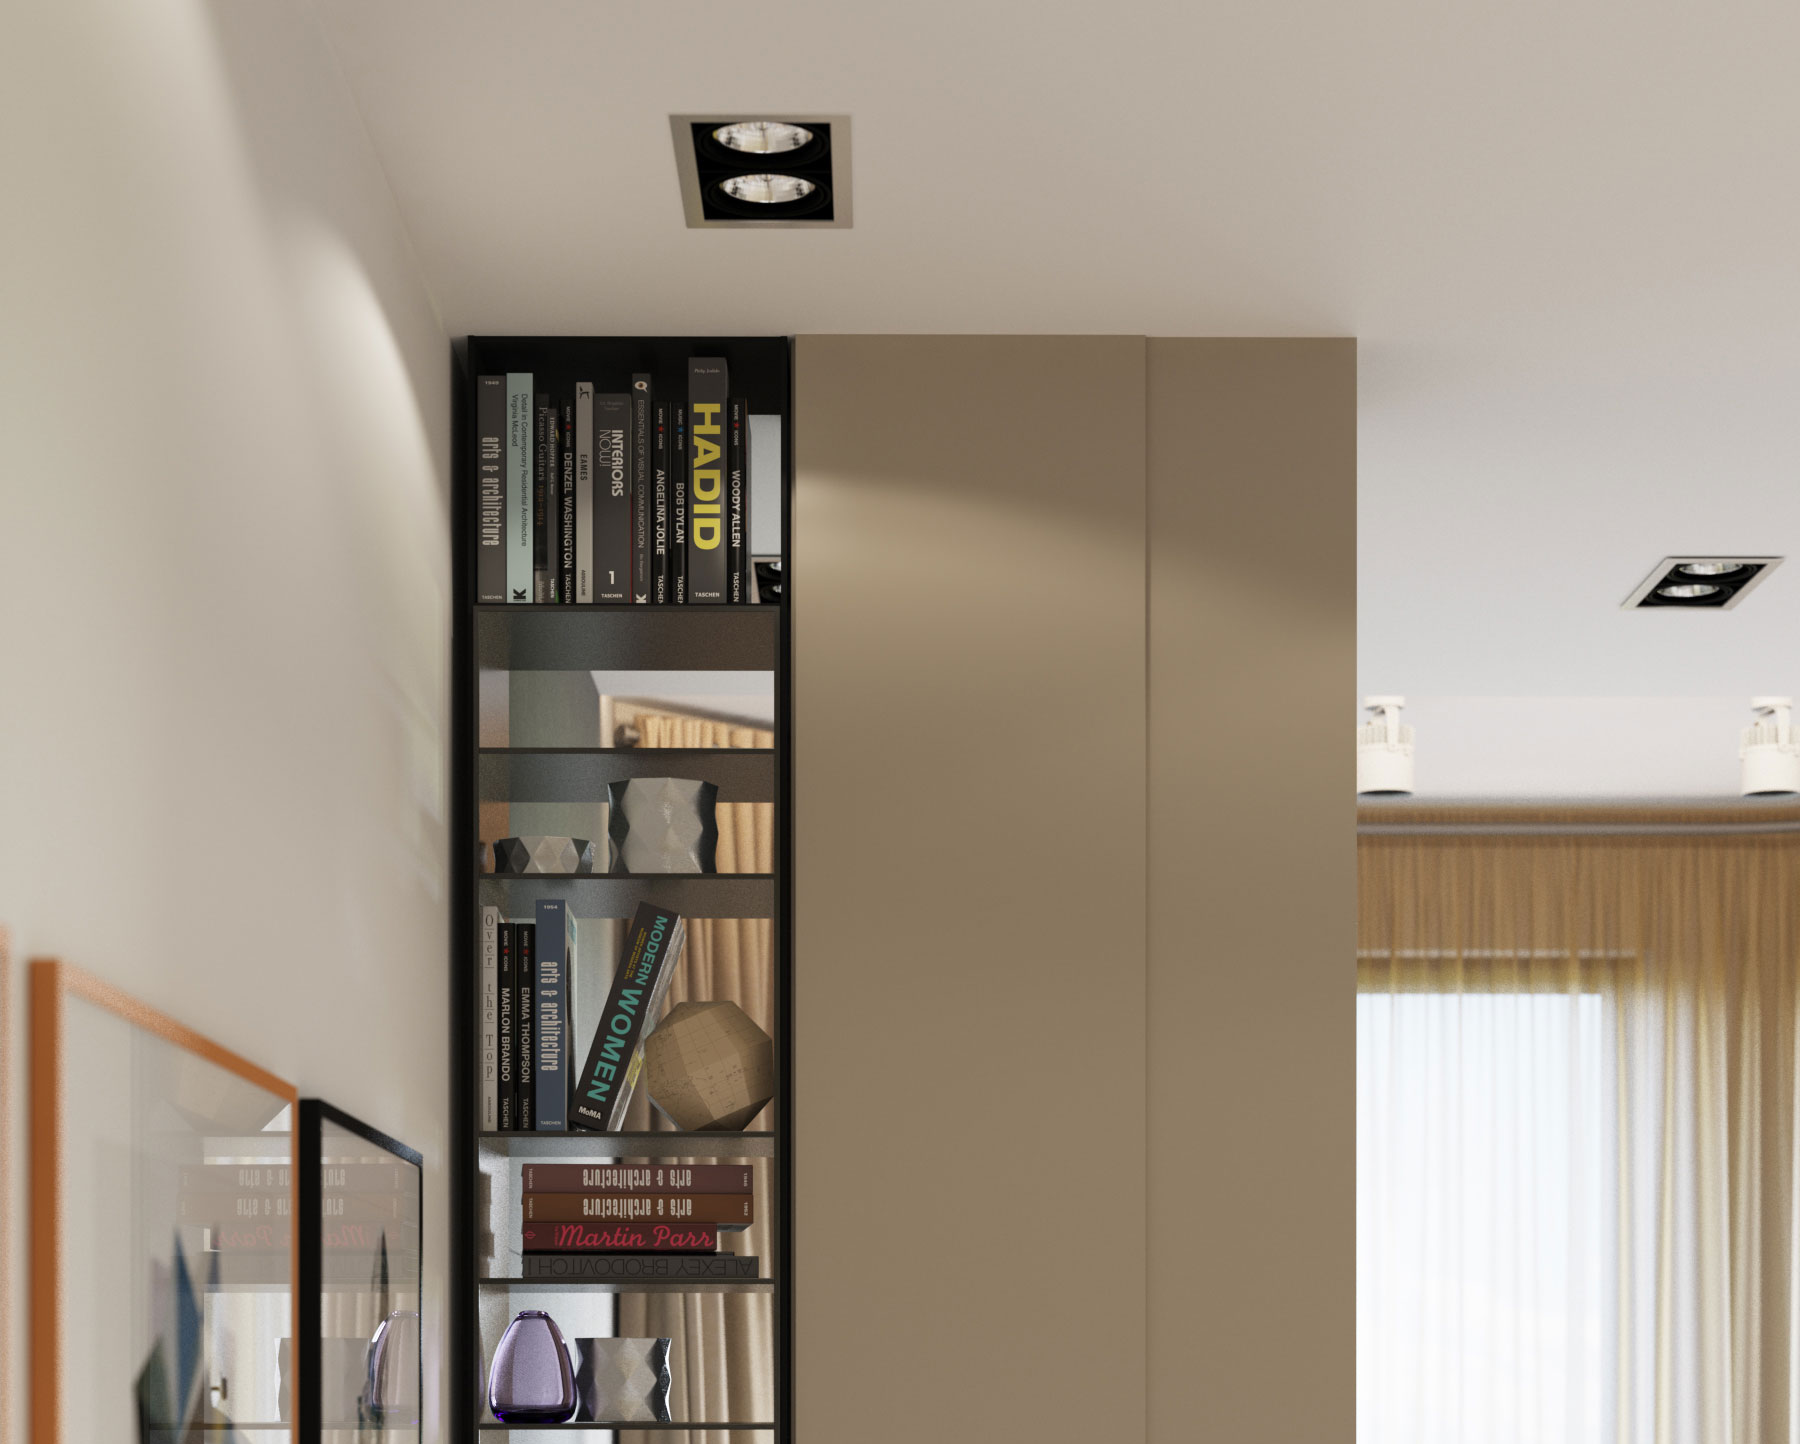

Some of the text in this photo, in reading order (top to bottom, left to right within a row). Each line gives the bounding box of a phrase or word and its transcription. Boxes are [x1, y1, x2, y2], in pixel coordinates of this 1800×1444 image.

[539, 407, 547, 441] Picasso
[482, 437, 502, 458] arts
[520, 422, 528, 467] Contemporary
[539, 444, 547, 480] Guitars
[599, 430, 611, 466] NOW!
[612, 430, 623, 496] INTERIORS
[638, 446, 644, 455] OF
[676, 483, 684, 505] BOB
[693, 403, 721, 550] HADID
[482, 478, 503, 545] architecture
[564, 453, 572, 568] DENZEL WASHINGTON
[656, 469, 664, 554] ANGELINA JOLIE
[732, 470, 740, 547] WOODY ALLEN
[631, 915, 668, 986] MODERN
[541, 962, 560, 984] arts
[502, 988, 510, 1081] MARLON BRANDO
[522, 988, 530, 1083] EMMA THOMPSON
[541, 1002, 562, 1071] architecture
[587, 988, 643, 1102] WOMEN
[578, 1105, 602, 1120] MoMA
[583, 1169, 691, 1190] arts & architecture
[583, 1199, 692, 1220] arts & architecture
[559, 1225, 645, 1247] Martin
[653, 1225, 714, 1247] Parr
[539, 1258, 752, 1275] ALEXEY BRODOVITCH
